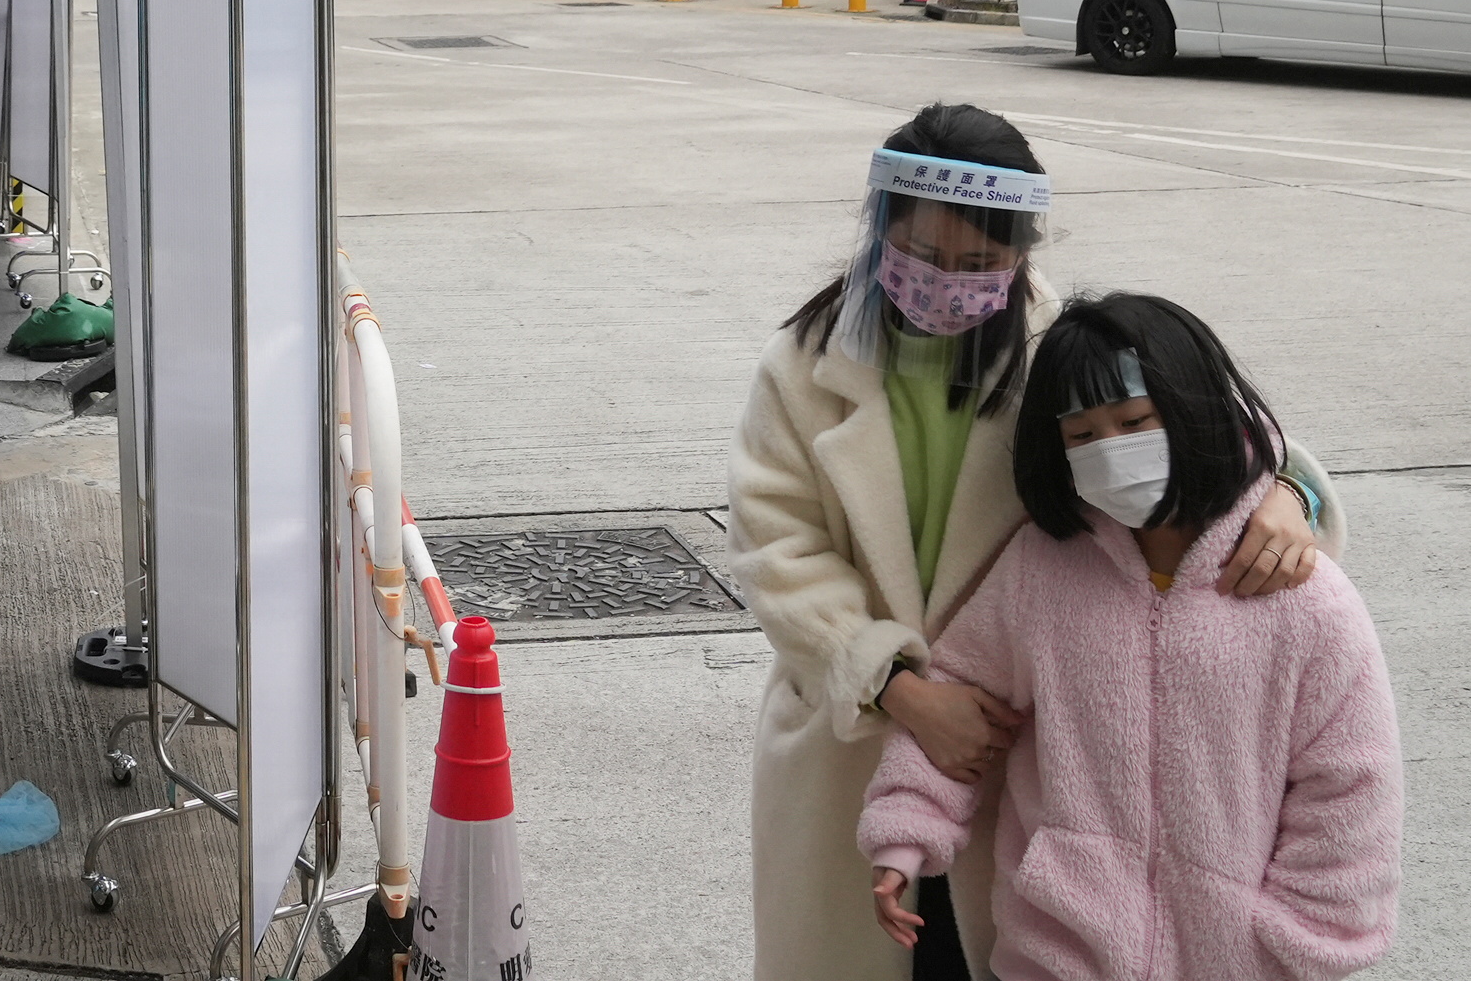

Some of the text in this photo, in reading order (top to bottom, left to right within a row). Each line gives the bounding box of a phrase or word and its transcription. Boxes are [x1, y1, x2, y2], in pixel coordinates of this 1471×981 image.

[892, 175, 950, 196] Protective
[952, 186, 984, 200] Face
[986, 190, 1023, 205] Shield
[913, 164, 999, 189] 保護面罩
